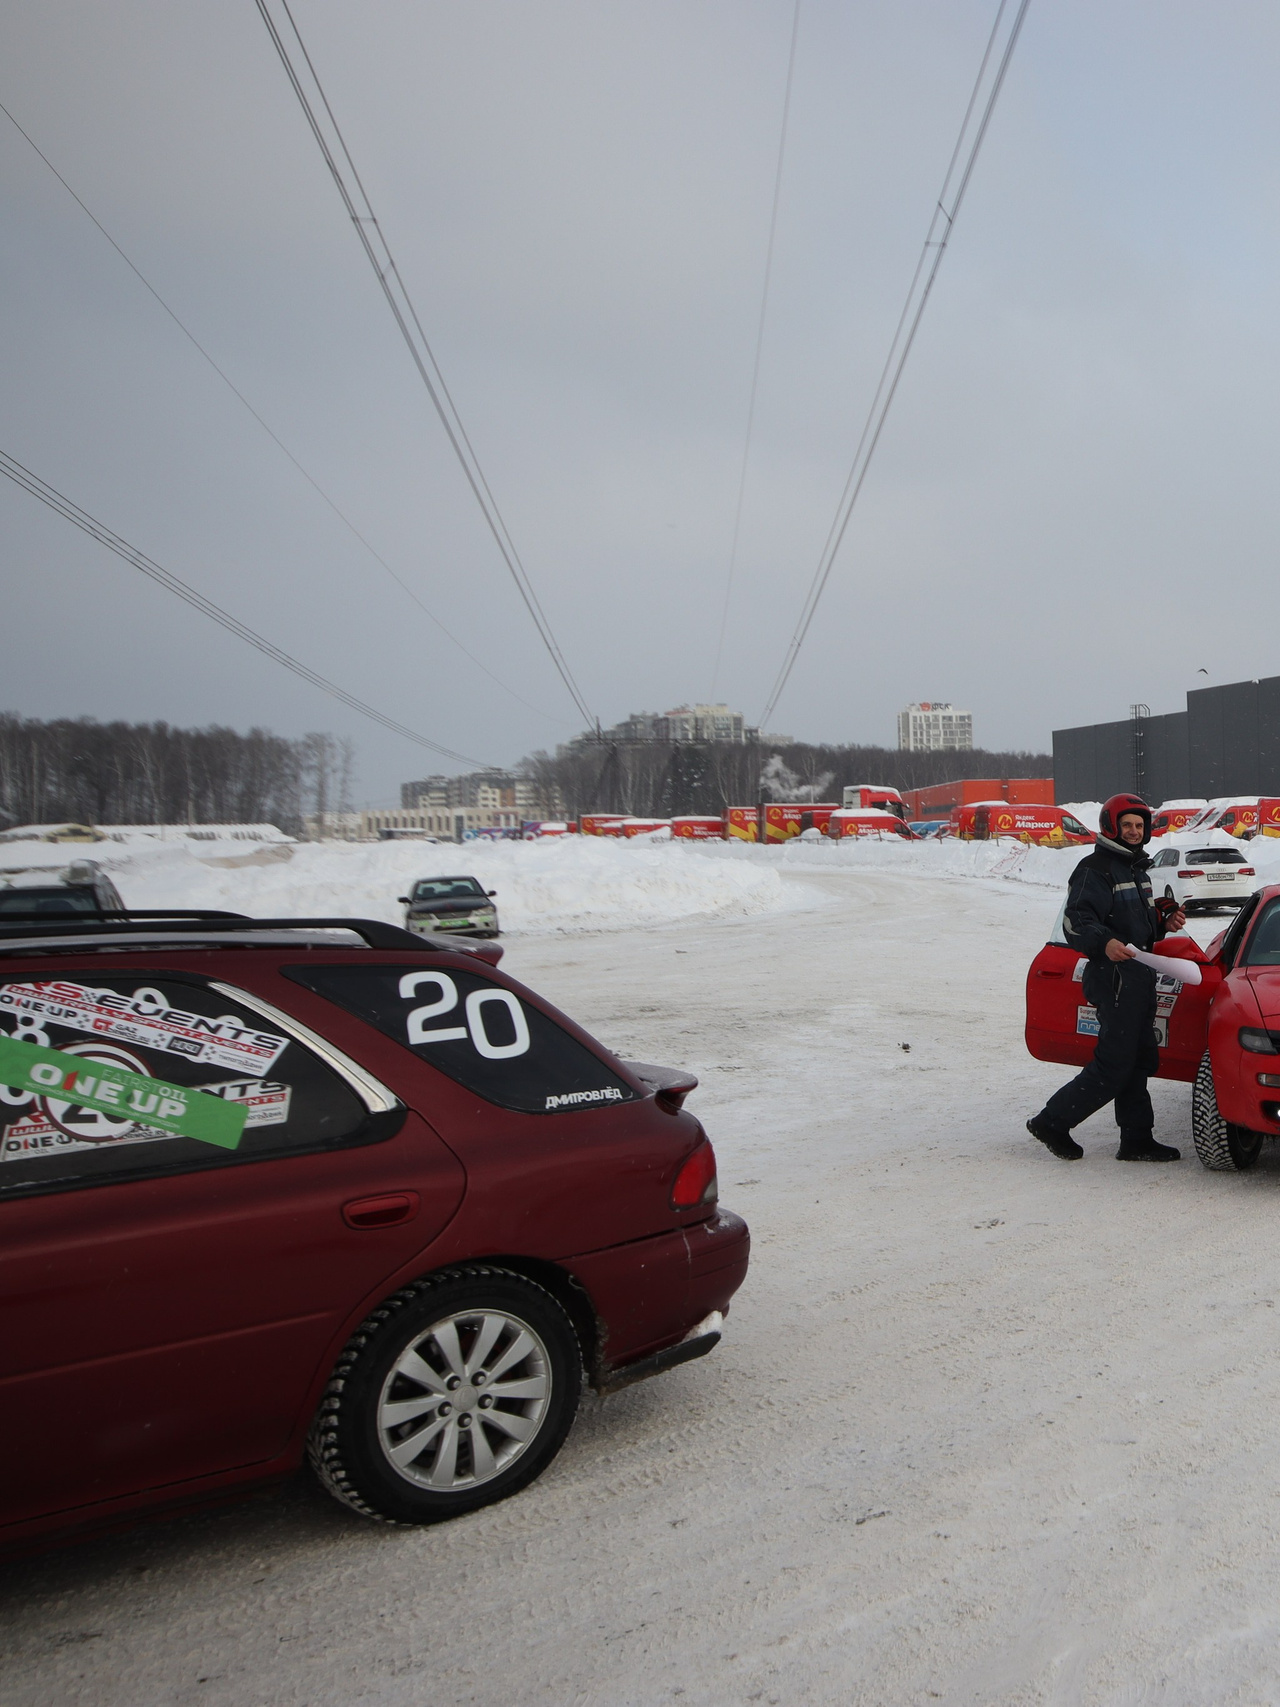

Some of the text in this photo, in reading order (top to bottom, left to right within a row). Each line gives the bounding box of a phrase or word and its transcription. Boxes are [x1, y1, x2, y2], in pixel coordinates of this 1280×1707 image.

[1014, 821, 1056, 830] Маркет
[0, 994, 78, 1019] ONE UP
[399, 970, 531, 1060] 20
[96, 994, 284, 1051] EVENTS
[29, 1062, 125, 1105] ONE
[126, 1087, 187, 1119] UP
[545, 1087, 623, 1110] ДМИТРОВЛЁД
[6, 1135, 54, 1152] ONE
